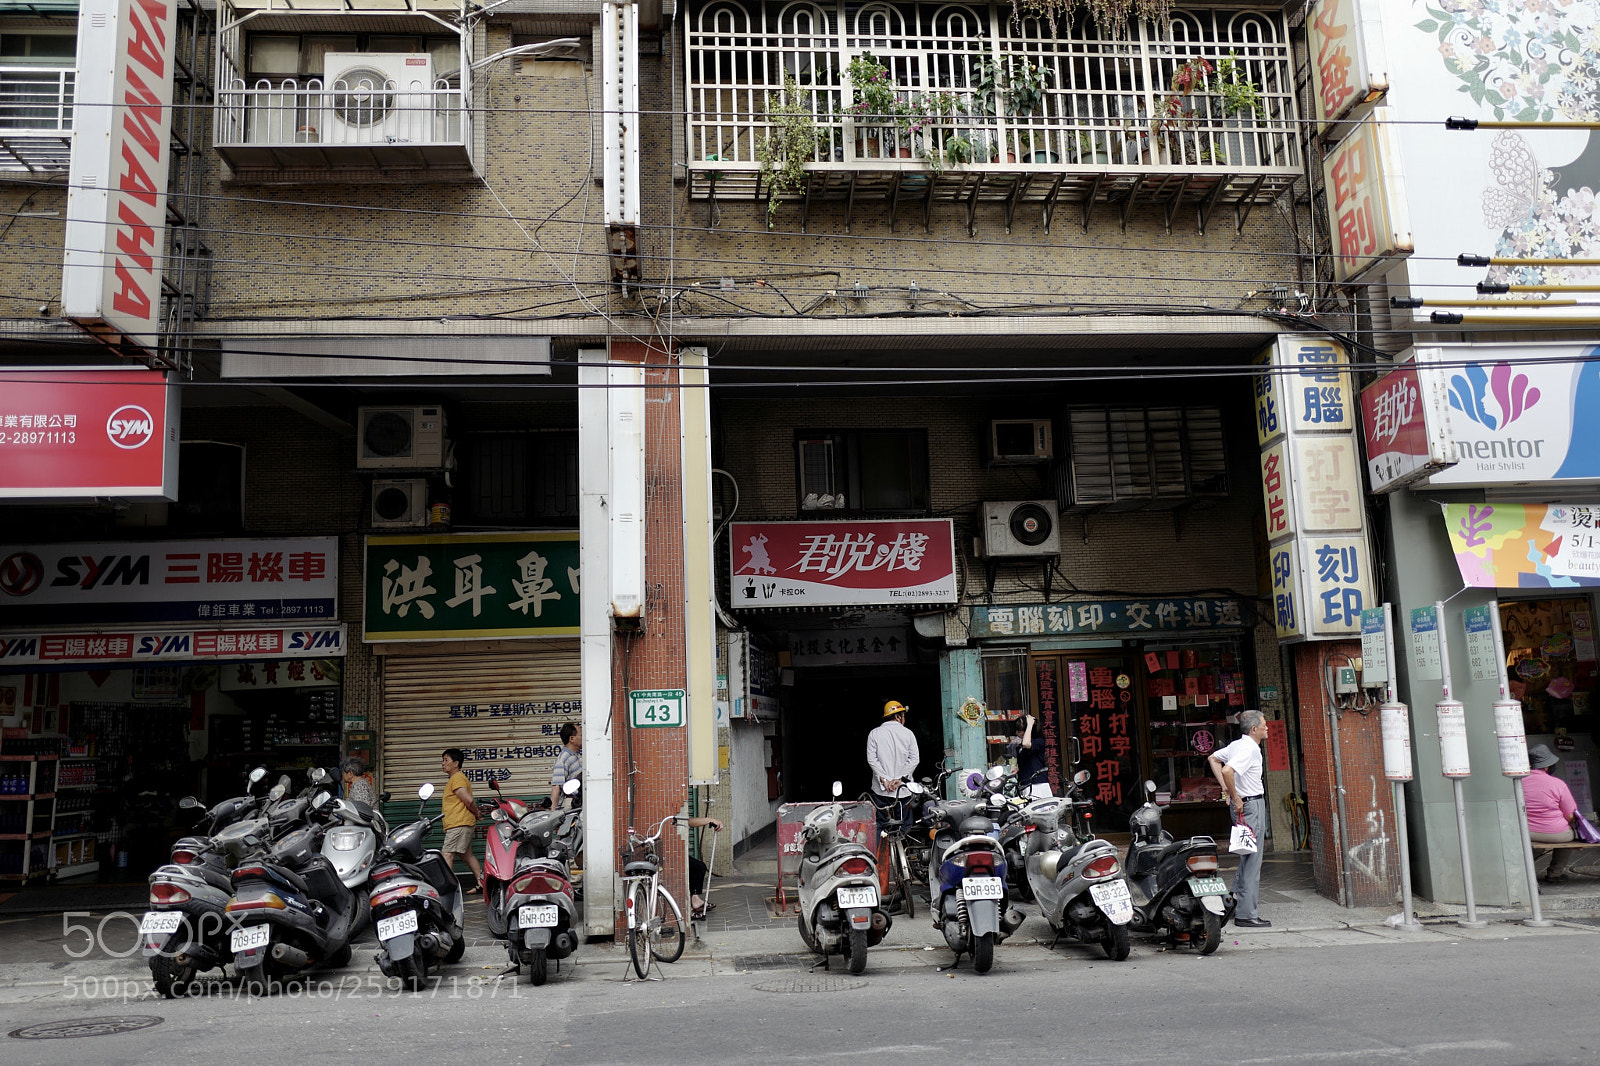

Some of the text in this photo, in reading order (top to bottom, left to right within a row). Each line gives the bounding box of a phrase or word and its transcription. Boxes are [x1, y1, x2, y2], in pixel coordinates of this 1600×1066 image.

[113, 0, 167, 320] YAMAHA
[1331, 137, 1376, 267] 印刷
[1298, 346, 1344, 423] 電腦
[0, 415, 77, 428] 業有限公司
[109, 420, 151, 439] SYM
[1457, 437, 1545, 459] mentor
[1477, 461, 1525, 471] Hair Stylist
[1264, 453, 1287, 533] 名片
[1304, 445, 1351, 525] 打字
[50, 551, 326, 590] SYM 三陽機車
[382, 550, 582, 620] 洪耳鼻
[1315, 544, 1362, 627] 刻印
[1272, 551, 1295, 631] 印刷
[198, 603, 256, 617] 偉鉅車業
[304, 605, 324, 614] 1113
[44, 637, 128, 656] 三陽機車
[137, 634, 189, 655] SYM
[197, 633, 278, 652] 三陽機車
[288, 631, 340, 650] SYM
[645, 704, 671, 721] 43
[839, 892, 875, 906] CJT-211
[233, 931, 268, 949] 709-EFX
